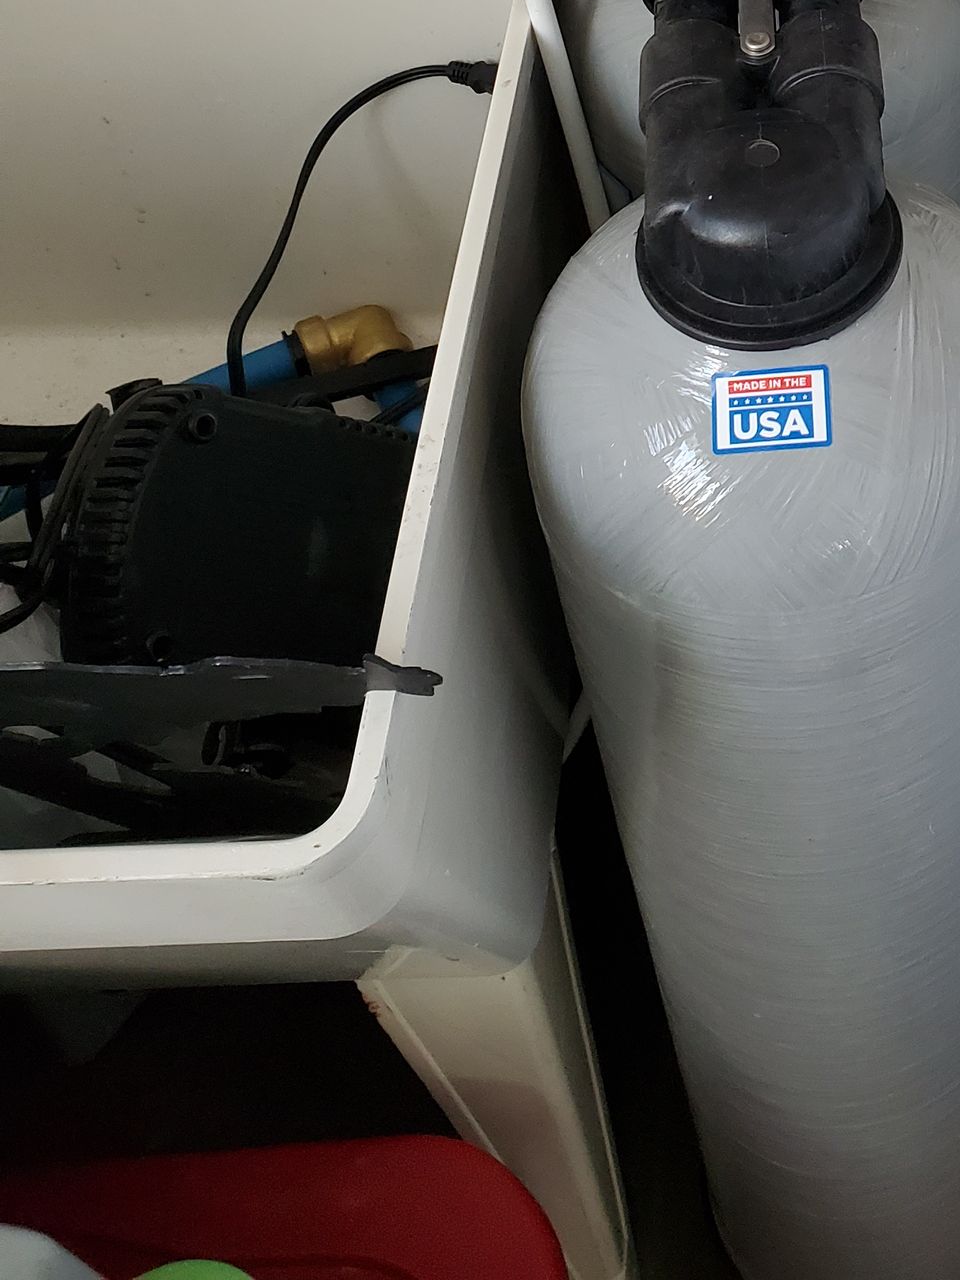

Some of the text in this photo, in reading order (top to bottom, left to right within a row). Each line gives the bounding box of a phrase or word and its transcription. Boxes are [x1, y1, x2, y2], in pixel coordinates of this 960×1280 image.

[733, 376, 807, 392] MADE IN THE
[733, 408, 810, 440] USA
